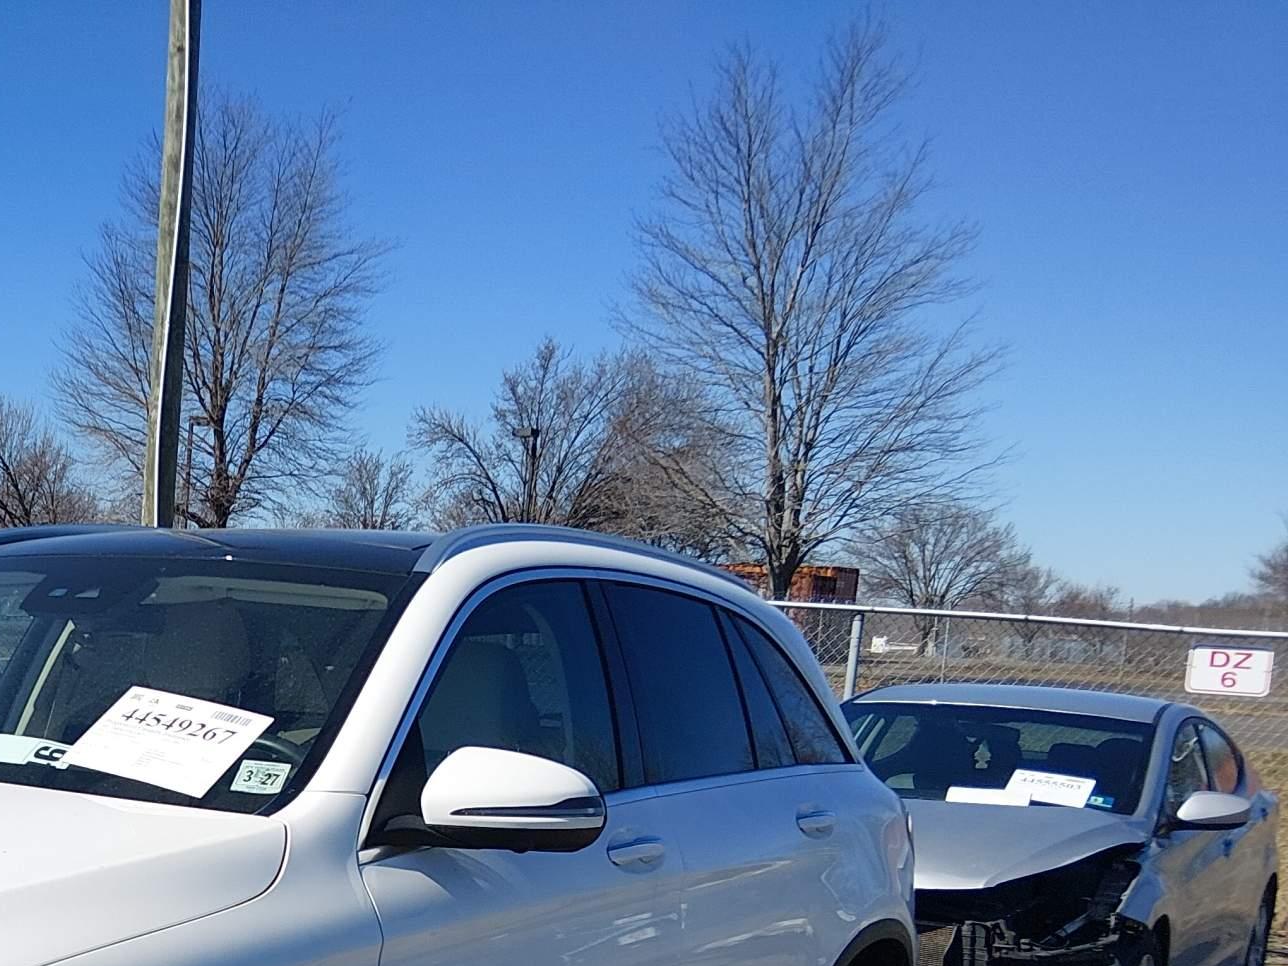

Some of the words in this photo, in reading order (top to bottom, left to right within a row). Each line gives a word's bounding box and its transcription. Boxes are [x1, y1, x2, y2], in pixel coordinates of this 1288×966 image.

[1209, 650, 1254, 670] DZ
[1220, 671, 1238, 688] 6
[121, 707, 239, 745] 44549267
[242, 769, 255, 783] 3
[259, 772, 281, 787] 27
